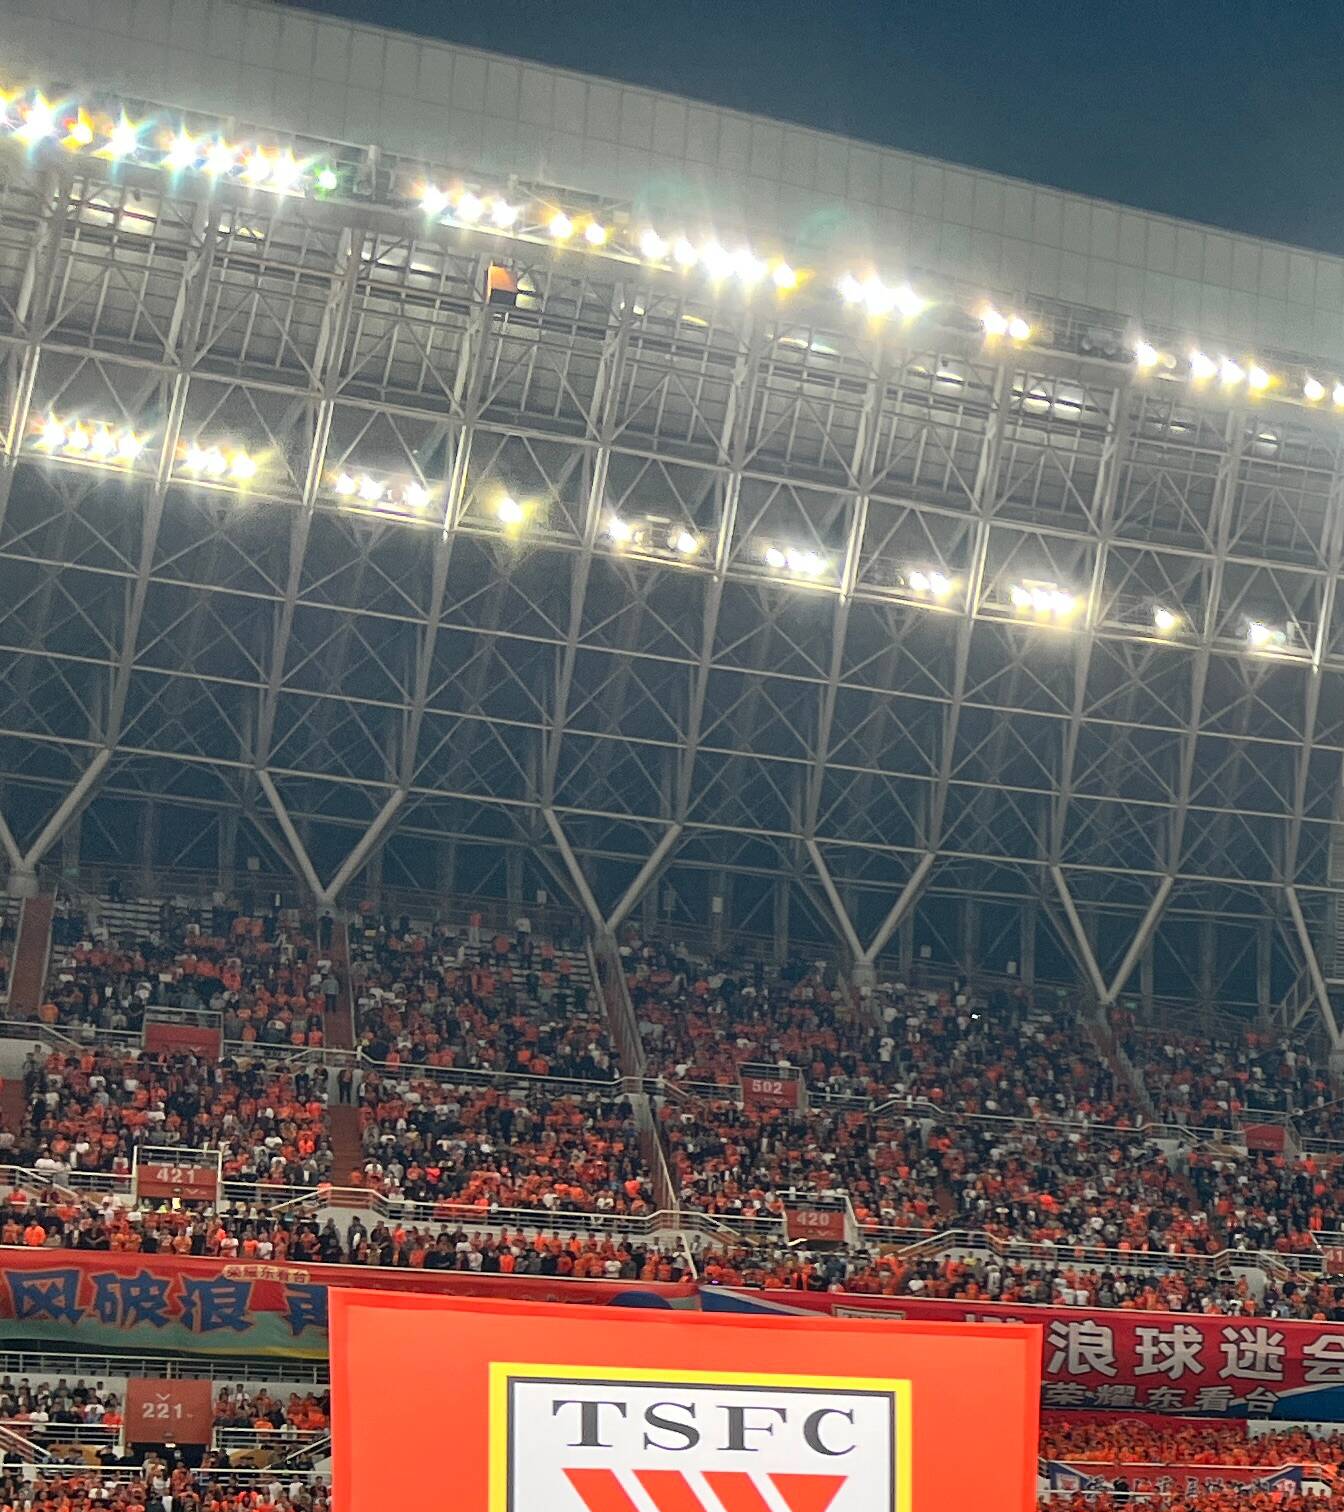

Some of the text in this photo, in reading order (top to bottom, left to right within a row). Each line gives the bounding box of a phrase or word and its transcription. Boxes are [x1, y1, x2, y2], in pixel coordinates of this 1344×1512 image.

[751, 1079, 784, 1095] 502
[156, 1166, 196, 1185] 421
[795, 1211, 831, 1227] 420
[1047, 1382, 1280, 1414] 荣耀东看台
[142, 1402, 184, 1419] 221
[551, 1399, 857, 1457] TSFC
